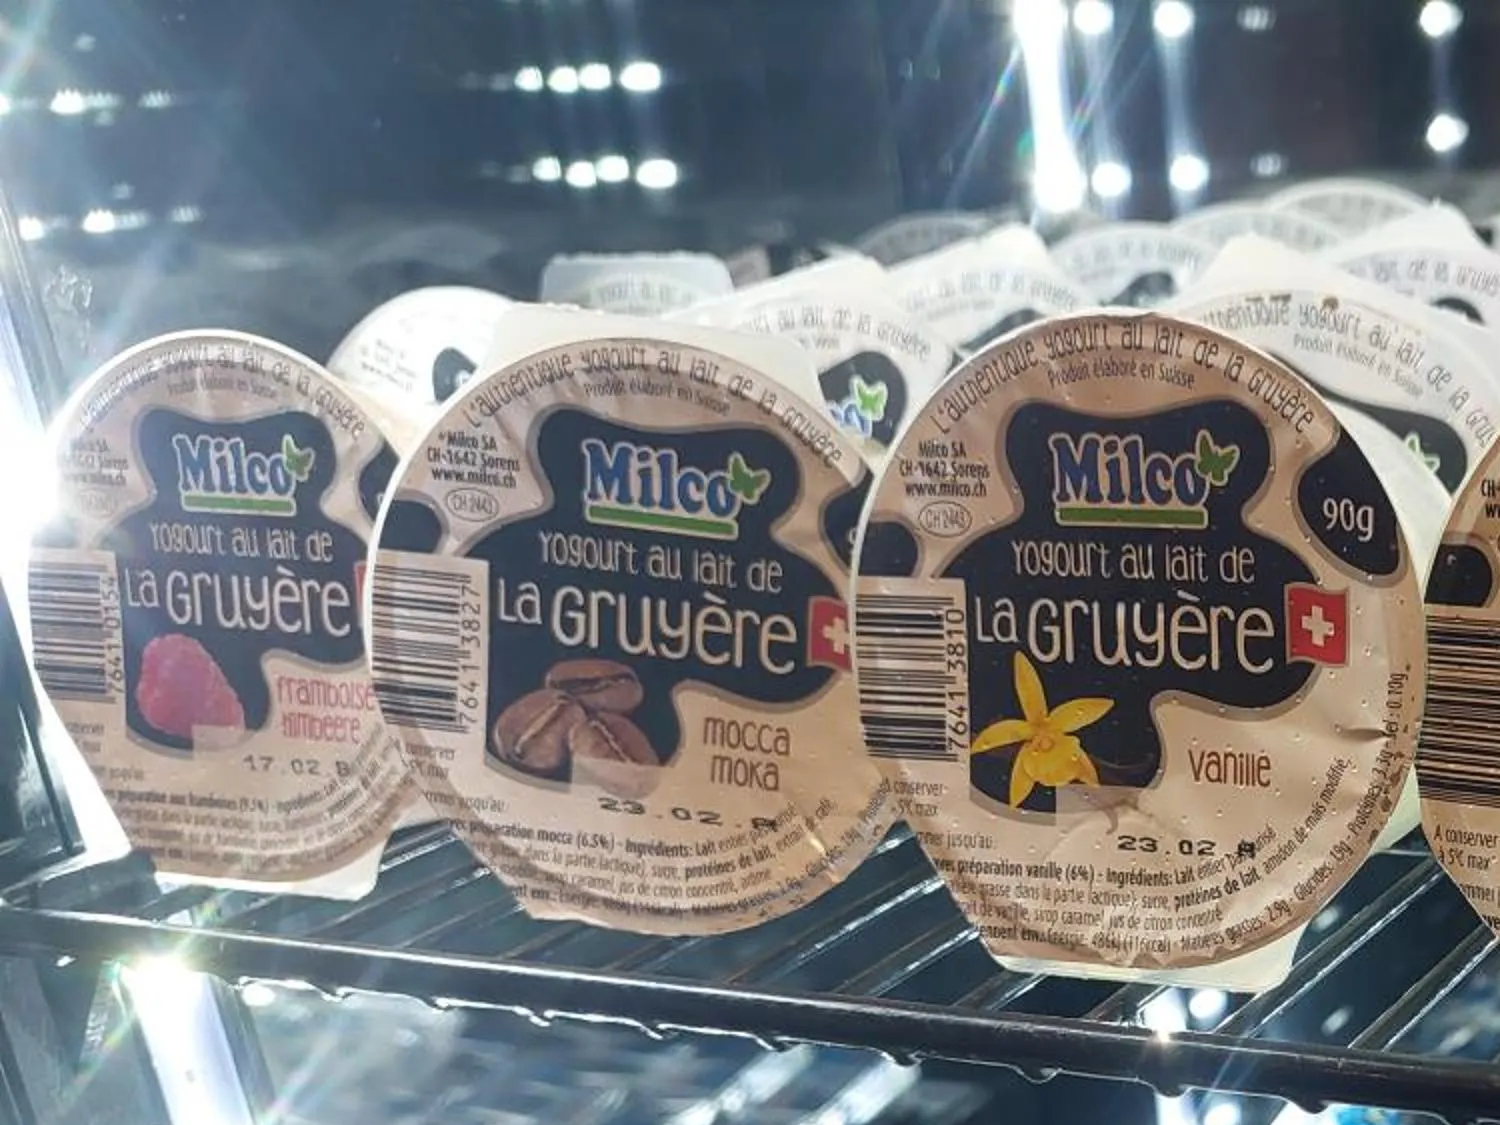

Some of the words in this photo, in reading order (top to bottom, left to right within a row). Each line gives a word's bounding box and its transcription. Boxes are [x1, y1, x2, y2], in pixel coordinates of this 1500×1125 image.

[657, 349, 681, 376] au
[690, 354, 721, 385] lait
[728, 372, 755, 402] de
[757, 384, 779, 413] la
[931, 340, 1039, 436] L'authentique
[1044, 323, 1113, 359] yogourt
[1120, 323, 1143, 351] au
[1153, 325, 1184, 360] lait
[1194, 338, 1222, 370] de
[1223, 351, 1246, 382] la
[1047, 362, 1090, 389] Produit
[1159, 362, 1196, 391] Suisse
[172, 432, 297, 497] Milco
[482, 434, 498, 452] SA
[918, 438, 949, 458] Milco
[951, 440, 967, 458] SA
[431, 467, 518, 489] www.milco.ch
[580, 438, 746, 518] Milco
[899, 459, 947, 478] CH-1642
[905, 481, 988, 497] www.milco.ch
[1048, 431, 1212, 509] Milco
[1322, 497, 1376, 543] 90g
[149, 521, 226, 556] Yogourt
[231, 524, 260, 558] au
[266, 525, 301, 562] lait
[304, 527, 334, 563] de
[539, 529, 640, 575] Yogourt
[646, 540, 683, 582] au
[692, 548, 738, 590] lait
[746, 555, 784, 595] de
[1012, 540, 1111, 578] Yogourt
[1121, 543, 1155, 580] au
[1164, 542, 1209, 584] lait
[1219, 545, 1257, 585] de
[124, 567, 161, 609] La
[165, 565, 351, 638] Gruyère
[498, 578, 543, 626] La
[550, 584, 798, 675] Gruyère
[974, 595, 1020, 646] La
[1026, 588, 1276, 676] Gruyère
[702, 715, 792, 757] mocca
[1187, 748, 1273, 789] Vanille
[1445, 829, 1499, 850] conserver
[957, 859, 1023, 880] préparation
